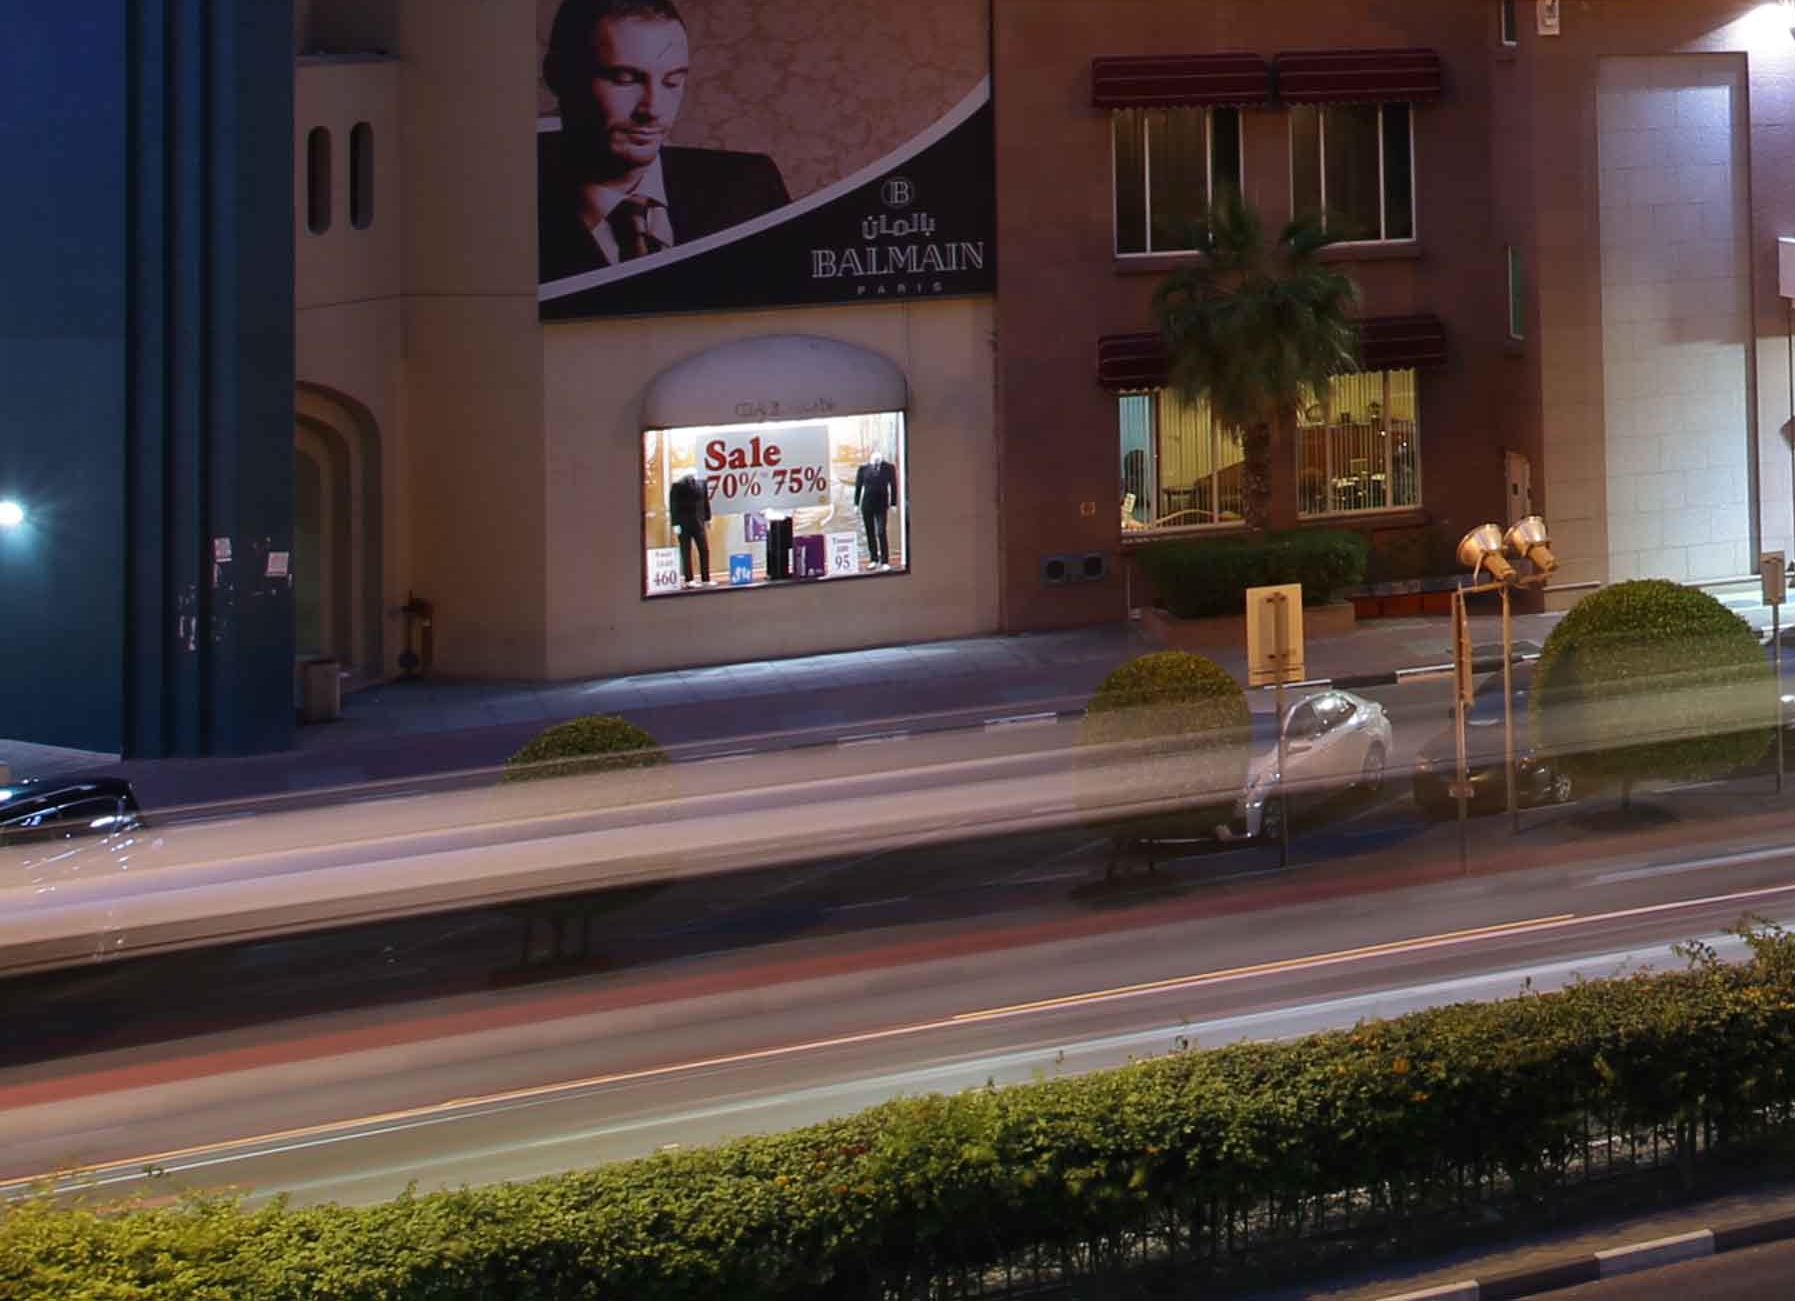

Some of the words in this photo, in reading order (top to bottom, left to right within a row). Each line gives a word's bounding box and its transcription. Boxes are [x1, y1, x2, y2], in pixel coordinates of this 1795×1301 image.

[861, 211, 936, 240] بالمان
[811, 241, 985, 279] BALMAIN
[857, 281, 944, 295] PARIS
[704, 436, 782, 471] Sale
[706, 471, 762, 501] 70%
[772, 465, 827, 496] 75%
